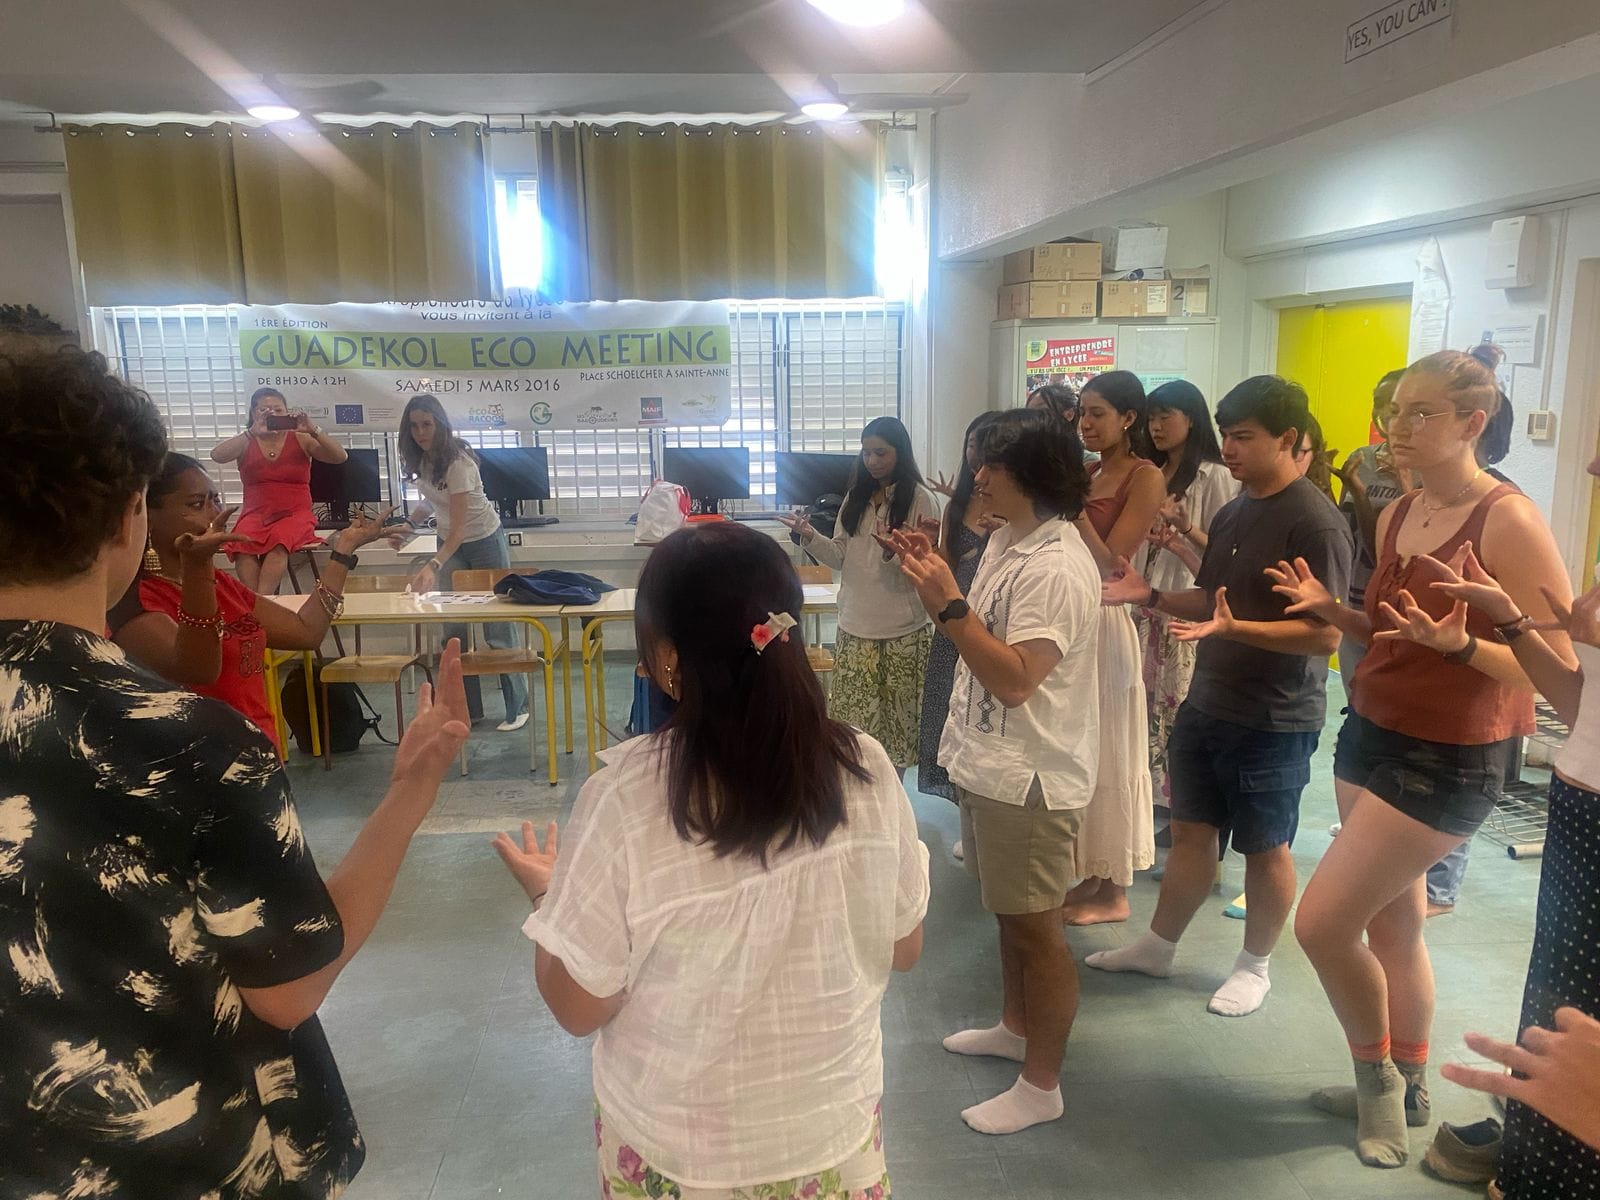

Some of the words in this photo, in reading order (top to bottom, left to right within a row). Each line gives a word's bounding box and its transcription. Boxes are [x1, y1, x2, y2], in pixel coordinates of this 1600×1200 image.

[1349, 27, 1371, 51] YES,
[1376, 10, 1405, 38] YOU
[1173, 285, 1184, 300] 2
[420, 311, 457, 320] vous
[463, 310, 519, 320] invitent
[524, 310, 533, 320] à
[539, 310, 552, 320] la
[282, 318, 328, 329] ÉDITION
[252, 334, 447, 368] GUADEKOL
[470, 336, 536, 367] ECO
[561, 331, 718, 366] MEETING
[1050, 339, 1113, 357] ENTREPRENDRE
[1051, 359, 1061, 368] EN
[257, 377, 271, 385] DE
[275, 376, 308, 385] 8H30
[310, 375, 319, 385] À
[323, 376, 347, 385] 12H
[580, 371, 604, 381] PLACE
[606, 369, 663, 380] SCHOELCHER
[675, 368, 729, 378] SAINTE-ANNE
[396, 379, 459, 392] SAMEDI
[466, 380, 473, 392] 5
[479, 379, 520, 392] MARS
[525, 379, 560, 392] 2016
[1366, 484, 1400, 499] ANTO
